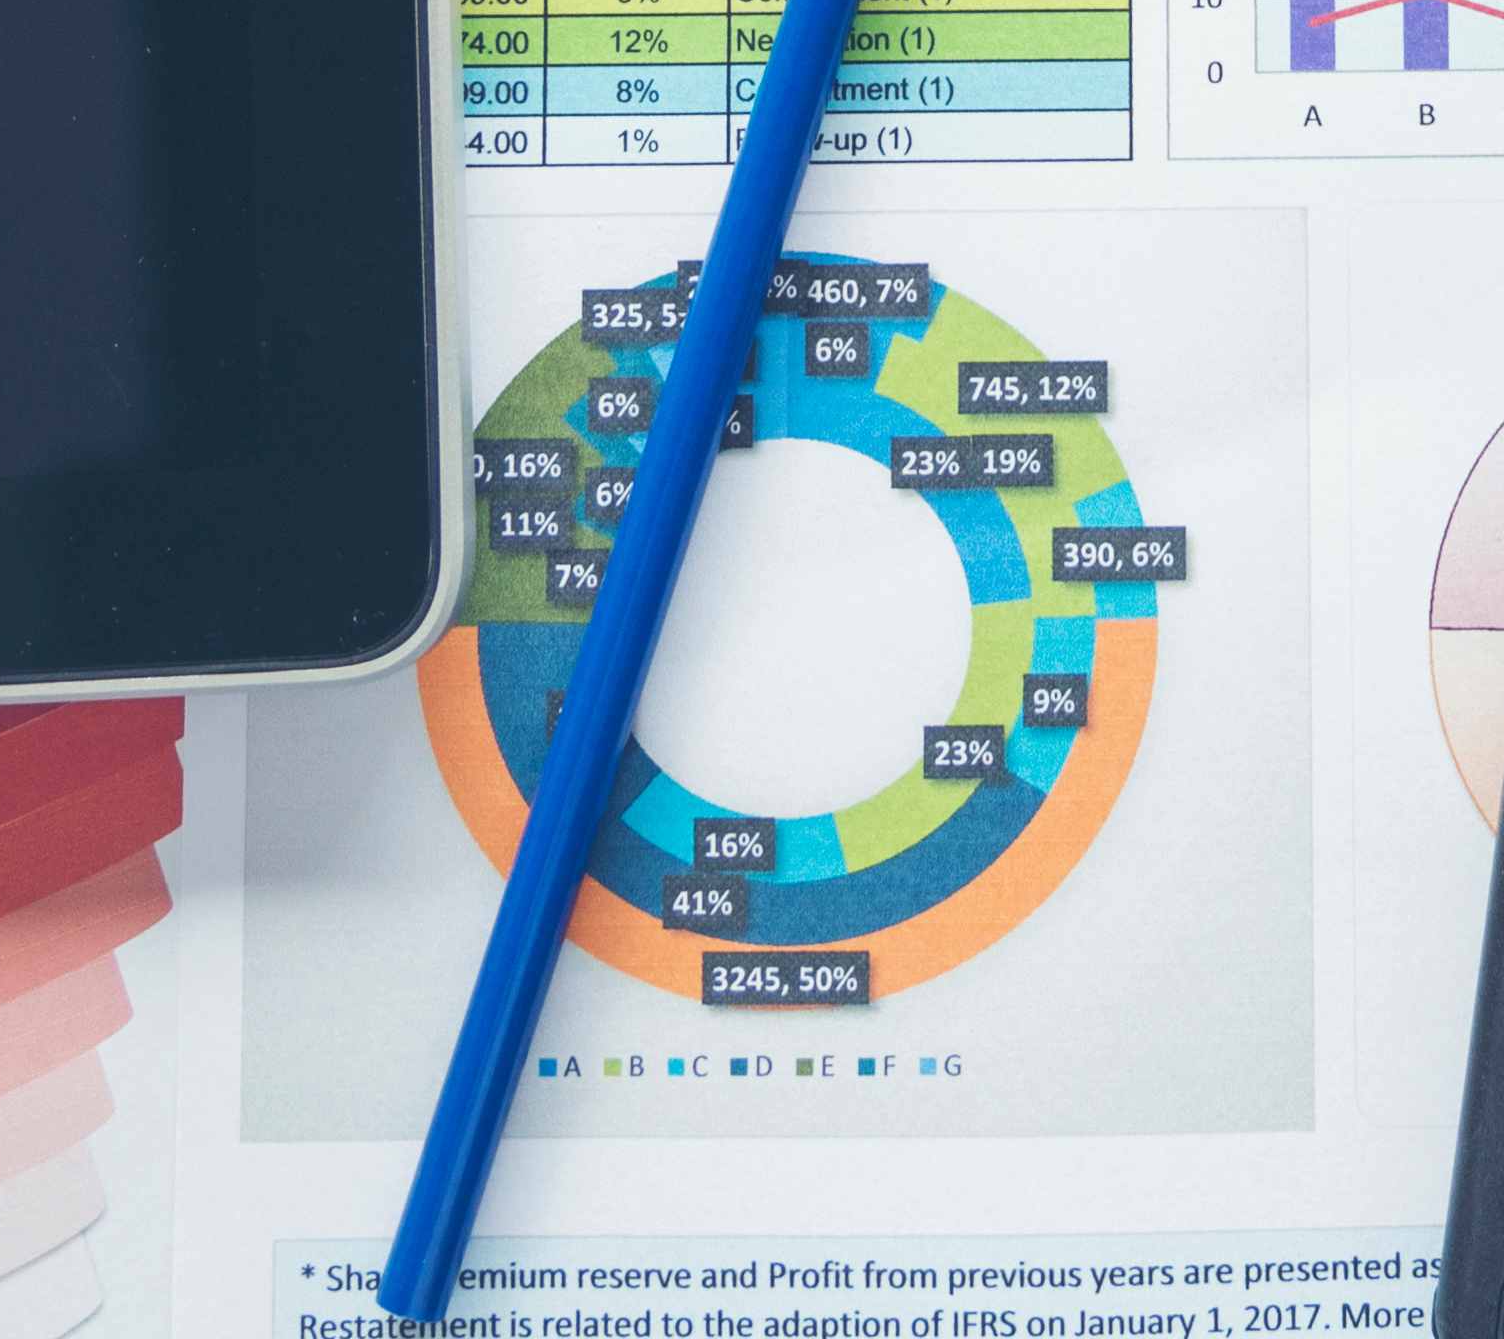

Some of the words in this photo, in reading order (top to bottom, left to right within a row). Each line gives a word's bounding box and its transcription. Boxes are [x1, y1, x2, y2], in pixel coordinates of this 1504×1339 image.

[611, 29, 668, 53] 12%
[1206, 59, 1223, 85] 0
[616, 79, 659, 103] 8%
[1304, 105, 1322, 127] A
[1420, 104, 1435, 126] B
[618, 129, 659, 153] 1%
[809, 280, 866, 308] 460,
[877, 278, 917, 302] 7%
[593, 303, 652, 331] 325,
[816, 337, 856, 362] 6%
[970, 377, 1028, 405] 745,
[1040, 376, 1096, 400] 12%
[598, 393, 639, 417] 6%
[504, 453, 561, 477] 16%
[902, 450, 960, 475] 23%
[984, 449, 1040, 474] 19%
[502, 511, 558, 536] 11%
[1064, 543, 1122, 571] 390,
[1133, 542, 1173, 566] 6%
[556, 564, 597, 588] 7%
[1034, 689, 1075, 714] 9%
[935, 740, 993, 765] 23%
[706, 833, 763, 857] 16%
[673, 890, 732, 915] 41%
[713, 967, 789, 996] 3245,
[800, 966, 857, 991] 50%
[578, 1269, 691, 1289] reserve
[702, 1261, 756, 1289] and
[770, 1260, 853, 1289] Profit
[863, 1260, 937, 1289] from
[949, 1261, 1082, 1295] previous
[1091, 1266, 1174, 1294] years
[1184, 1264, 1233, 1285] are
[1245, 1252, 1401, 1290] presented
[300, 1313, 501, 1339] Restatement
[511, 1312, 532, 1338] is
[543, 1310, 650, 1337] related
[662, 1313, 693, 1337] to
[704, 1310, 753, 1337] the
[764, 1310, 900, 1339] adaption
[911, 1309, 943, 1338] of
[954, 1311, 1016, 1337] IFRS
[1027, 1317, 1065, 1337] on
[1075, 1311, 1195, 1339] January
[1208, 1307, 1232, 1338] 1,
[1245, 1304, 1330, 1331] 2017.
[1342, 1303, 1424, 1328] More
